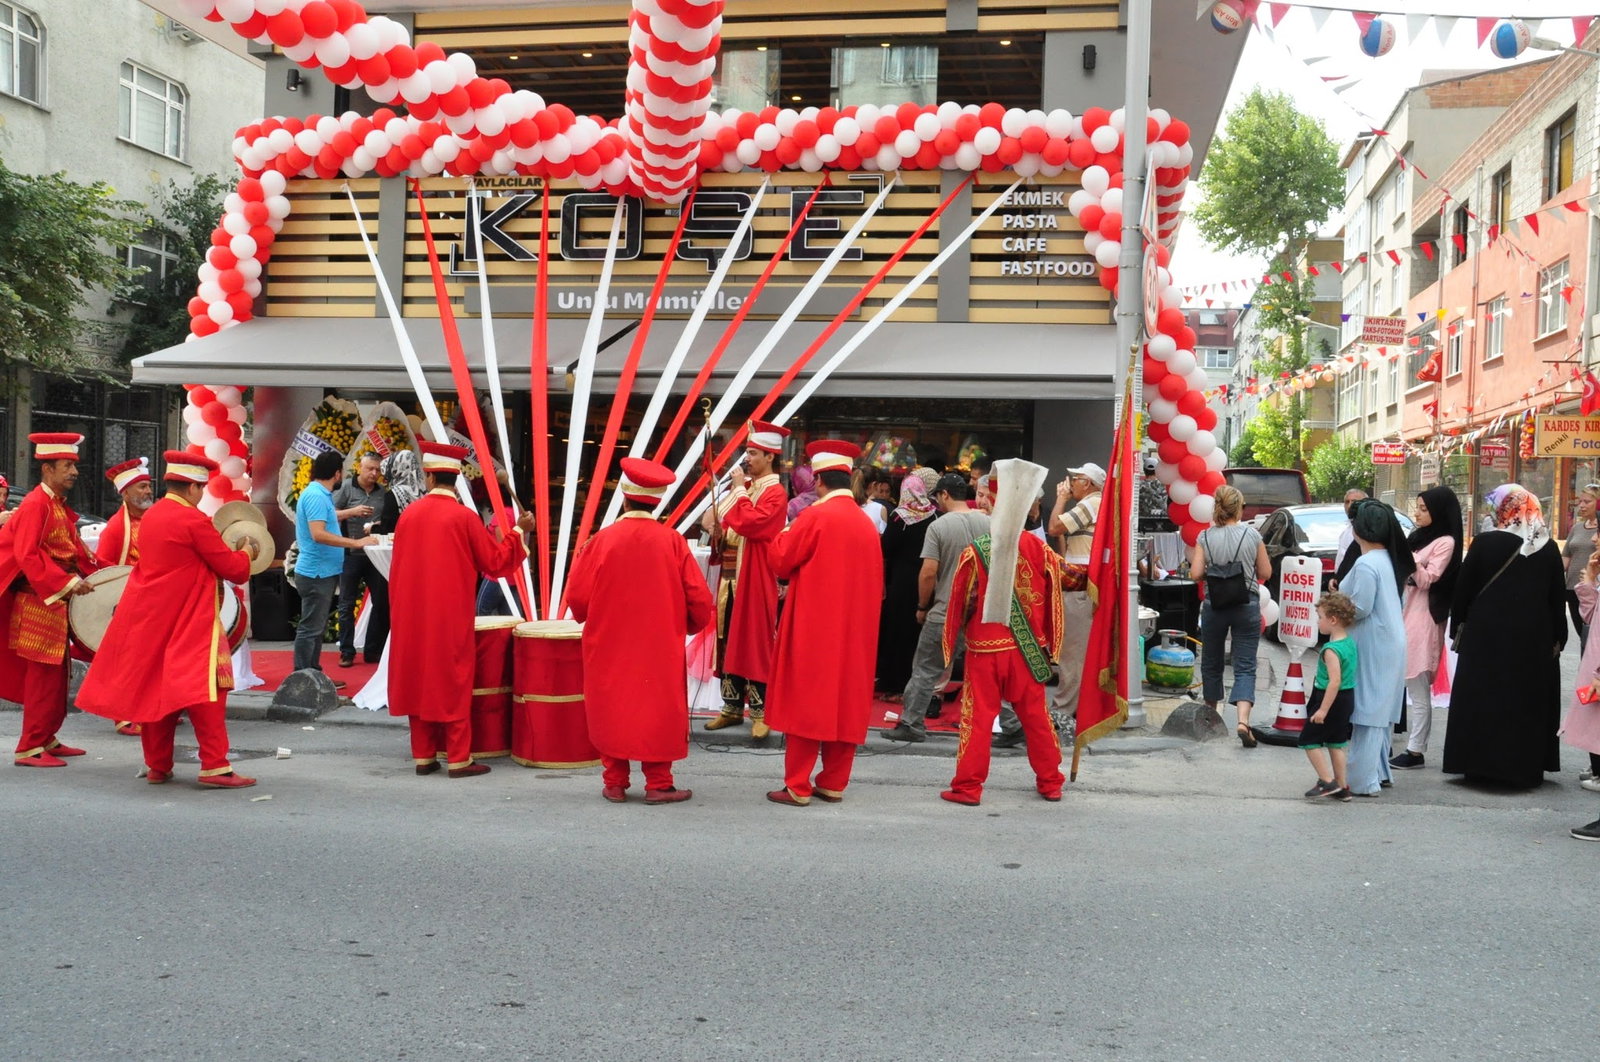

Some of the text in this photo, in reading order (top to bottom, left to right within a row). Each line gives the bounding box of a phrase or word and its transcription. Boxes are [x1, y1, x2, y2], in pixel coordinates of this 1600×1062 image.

[1003, 191, 1065, 206] EKMEK
[1002, 214, 1058, 229] PASTA
[1001, 236, 1047, 252] CAFE
[1000, 260, 1096, 276] FASTFOOD
[1543, 420, 1581, 434] KARDEŞ
[1543, 432, 1569, 454] Renkli
[1283, 570, 1315, 588] KÖŞE
[1282, 590, 1313, 603] FIRIN
[1280, 622, 1311, 638] PARK ALANI
